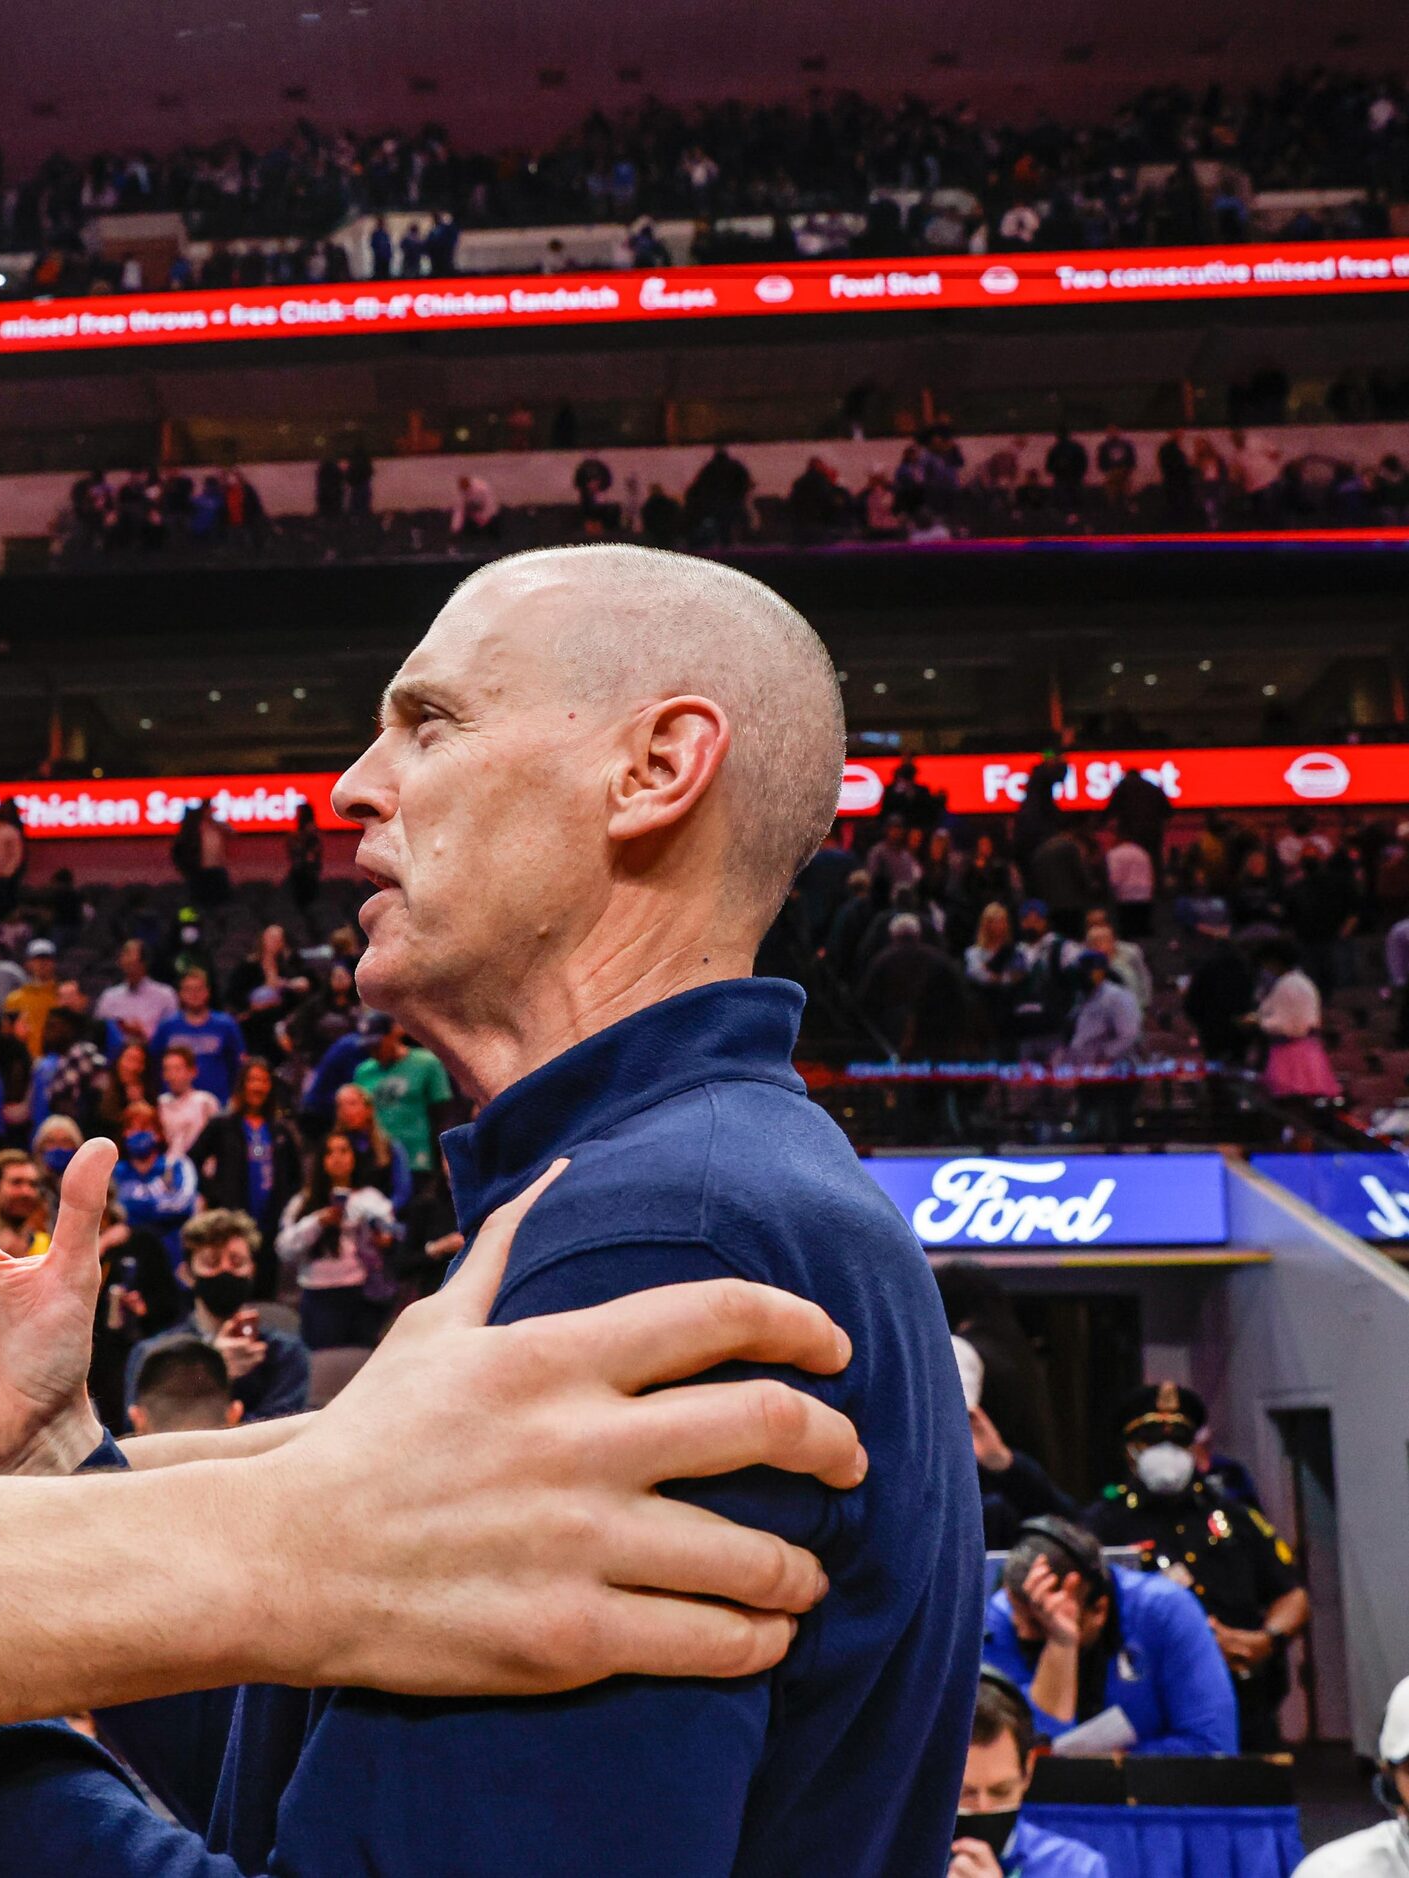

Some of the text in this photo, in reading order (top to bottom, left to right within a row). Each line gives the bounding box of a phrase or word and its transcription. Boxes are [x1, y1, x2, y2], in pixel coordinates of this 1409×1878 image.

[886, 271, 941, 296] Shot
[1056, 265, 1107, 290] Two
[1338, 255, 1390, 279] free
[79, 312, 127, 334] free
[229, 303, 278, 327] free
[413, 292, 508, 318] Chicken
[509, 285, 619, 313] Sandwich
[913, 1158, 1116, 1243] Ford
